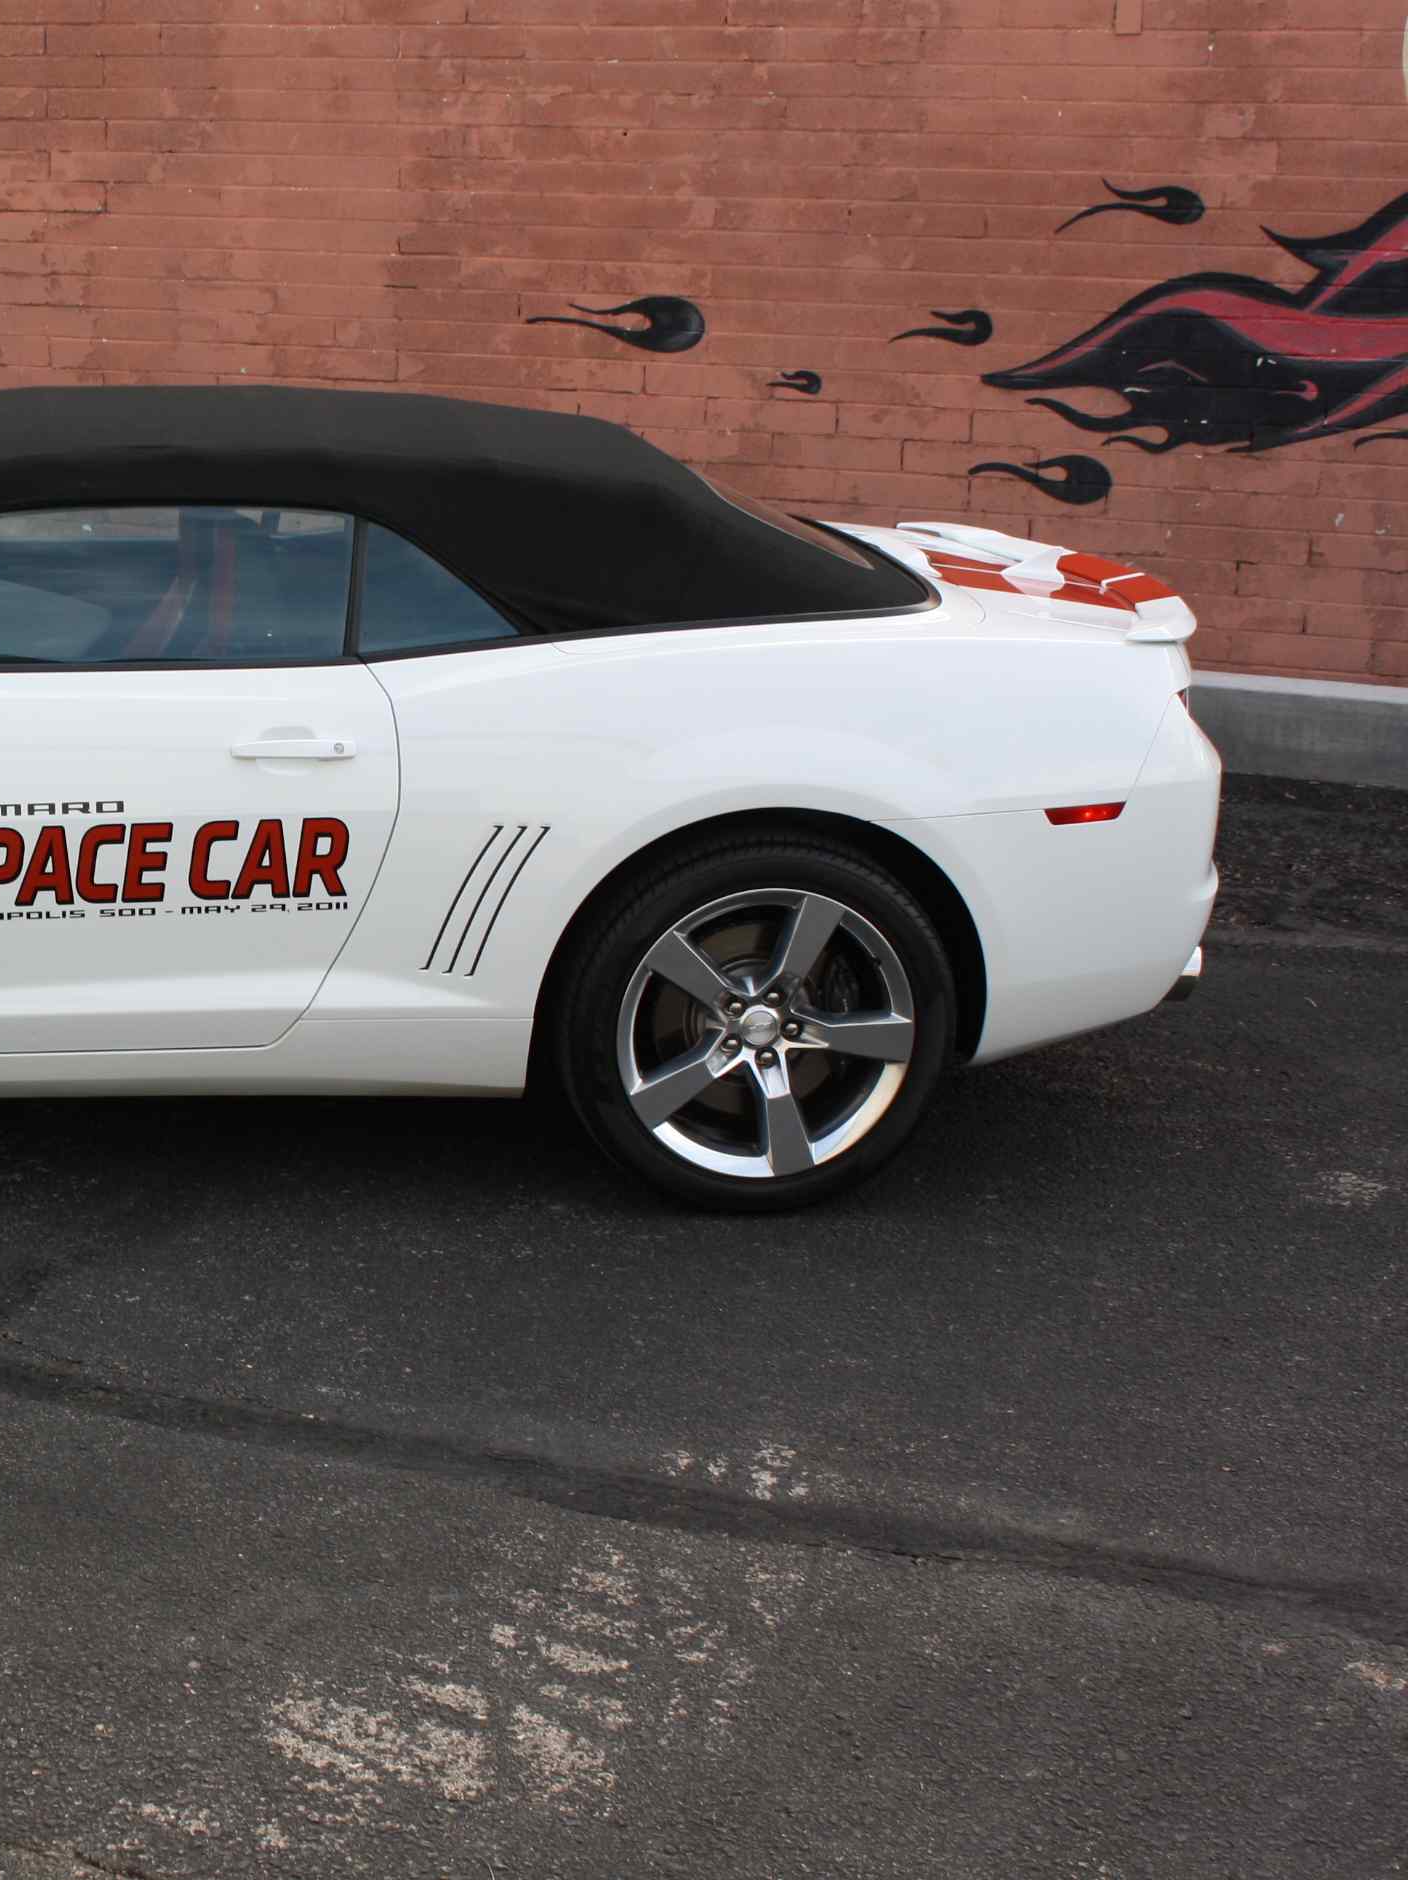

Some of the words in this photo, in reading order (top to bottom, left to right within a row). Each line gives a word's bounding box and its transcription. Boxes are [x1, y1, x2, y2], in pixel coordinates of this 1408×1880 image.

[187, 816, 350, 902] CAR
[99, 907, 157, 918] 500
[180, 904, 242, 916] MAY
[250, 903, 290, 914] 29,
[296, 901, 349, 912] 2011
